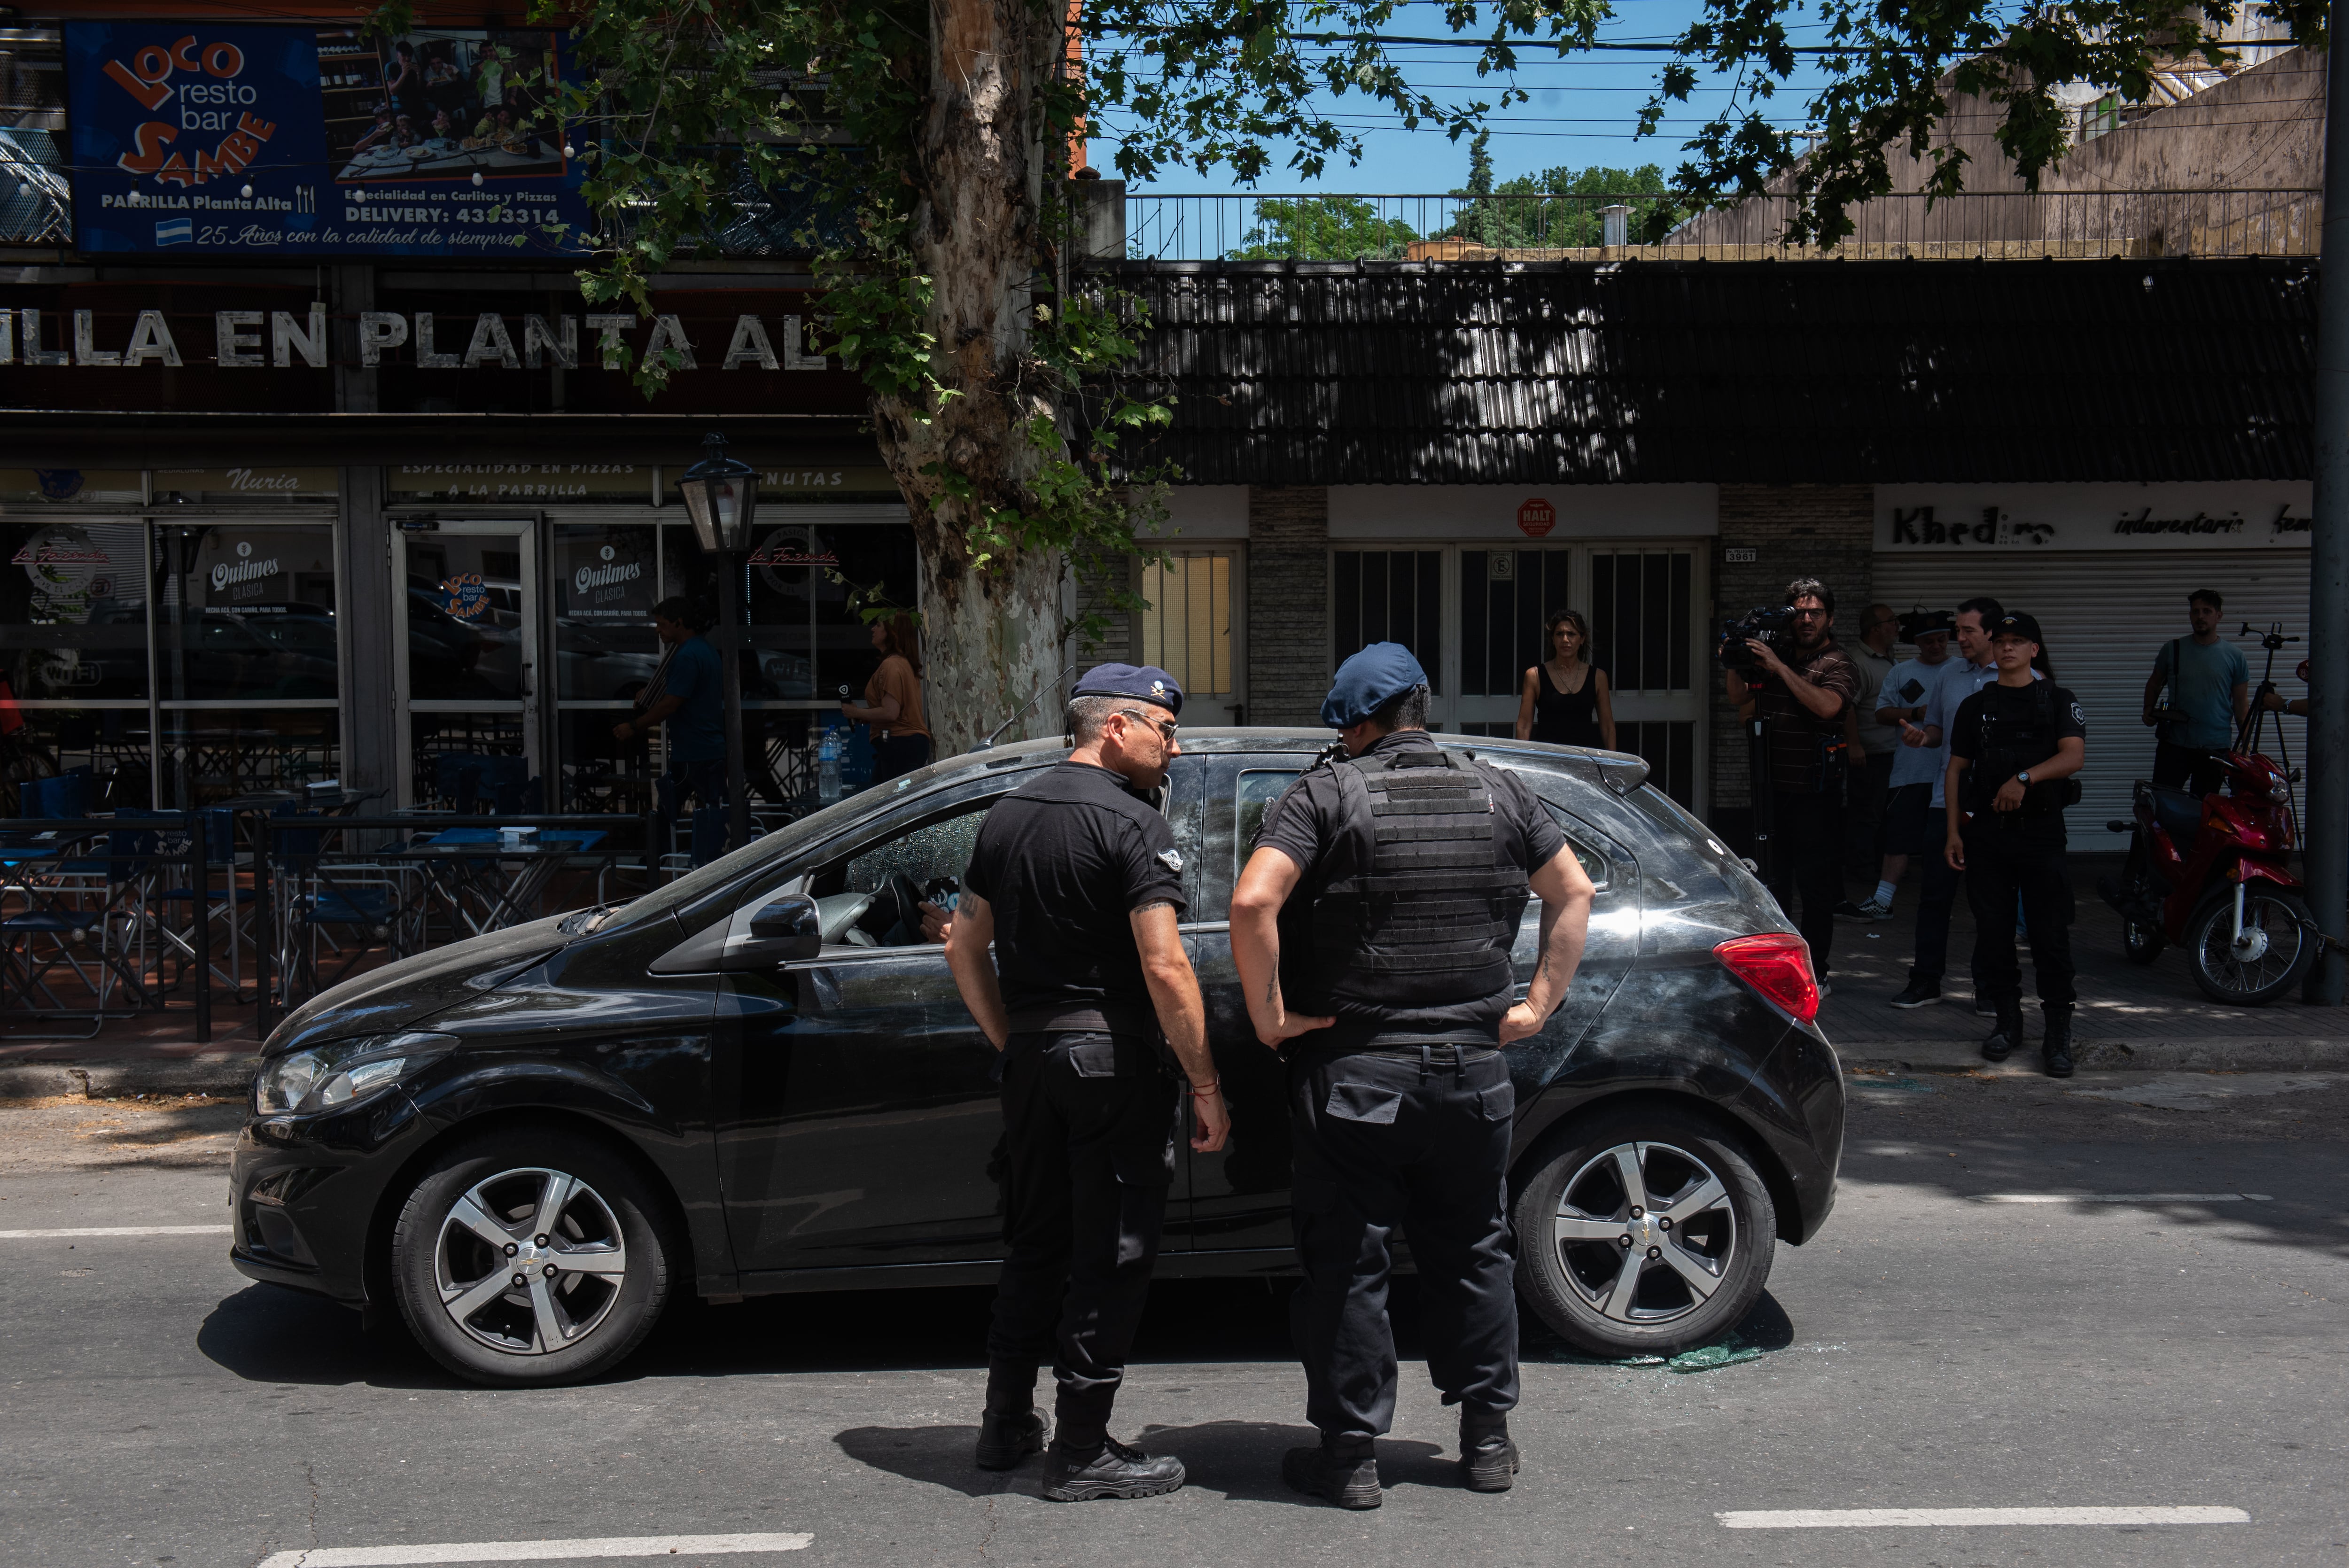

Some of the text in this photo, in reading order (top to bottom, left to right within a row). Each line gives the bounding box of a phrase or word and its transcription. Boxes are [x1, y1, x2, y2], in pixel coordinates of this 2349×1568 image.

[102, 35, 244, 111] LOCO
[179, 80, 257, 104] resto
[181, 104, 232, 130] bar
[117, 111, 277, 188] SAMBE
[194, 196, 252, 210] Planta
[257, 196, 292, 210] Alta
[344, 189, 557, 203] Esecialidad en Carlitos y Pizzas
[345, 207, 450, 223] DELIVERY:
[196, 224, 514, 250] 25 Años con la calidad de siempre
[216, 310, 327, 368] EN
[361, 311, 699, 370] PLANTA
[226, 468, 300, 490] Nuria
[403, 465, 635, 474] ESPECIALIDAD EN PIZZAS
[448, 484, 587, 496] A LA PARRILLA
[1523, 510, 1551, 521] HALT
[11, 544, 110, 567] La Fazenda
[747, 544, 840, 568] La Fazenda
[212, 558, 279, 592] Quilmes
[442, 572, 482, 596] LOCO
[576, 562, 640, 595] Quilmes
[233, 582, 264, 600] CLÁSICA
[463, 593, 478, 601] bar
[595, 586, 625, 604] CLÁSICA
[445, 595, 490, 619] SAMBE
[154, 838, 192, 856] SAMBE
[167, 835, 181, 844] bar
[1528, 1211, 1579, 1322] BRIDGESTONE
[567, 1341, 613, 1370] PIRELLI
